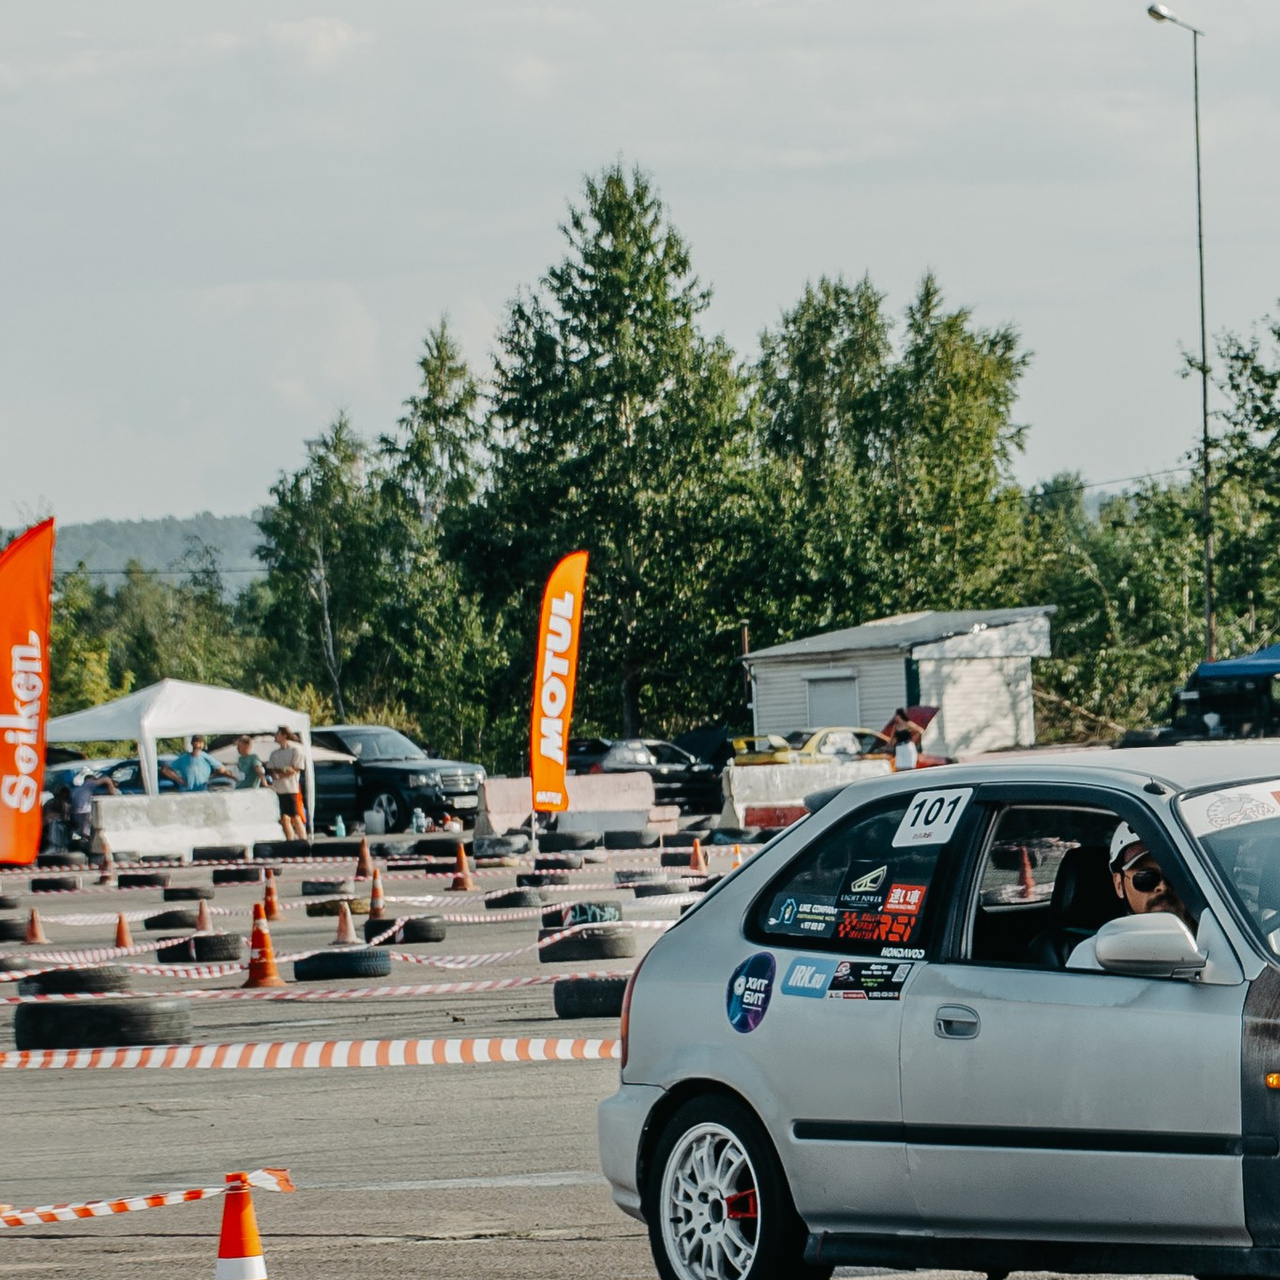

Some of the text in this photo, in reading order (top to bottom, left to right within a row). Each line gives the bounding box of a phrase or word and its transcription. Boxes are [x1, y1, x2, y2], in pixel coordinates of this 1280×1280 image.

[540, 590, 575, 766] MOTUL
[910, 795, 963, 828] 101
[746, 977, 769, 991] ХИТ
[788, 965, 827, 989] IRK.RU
[743, 991, 765, 1005] БИТ
